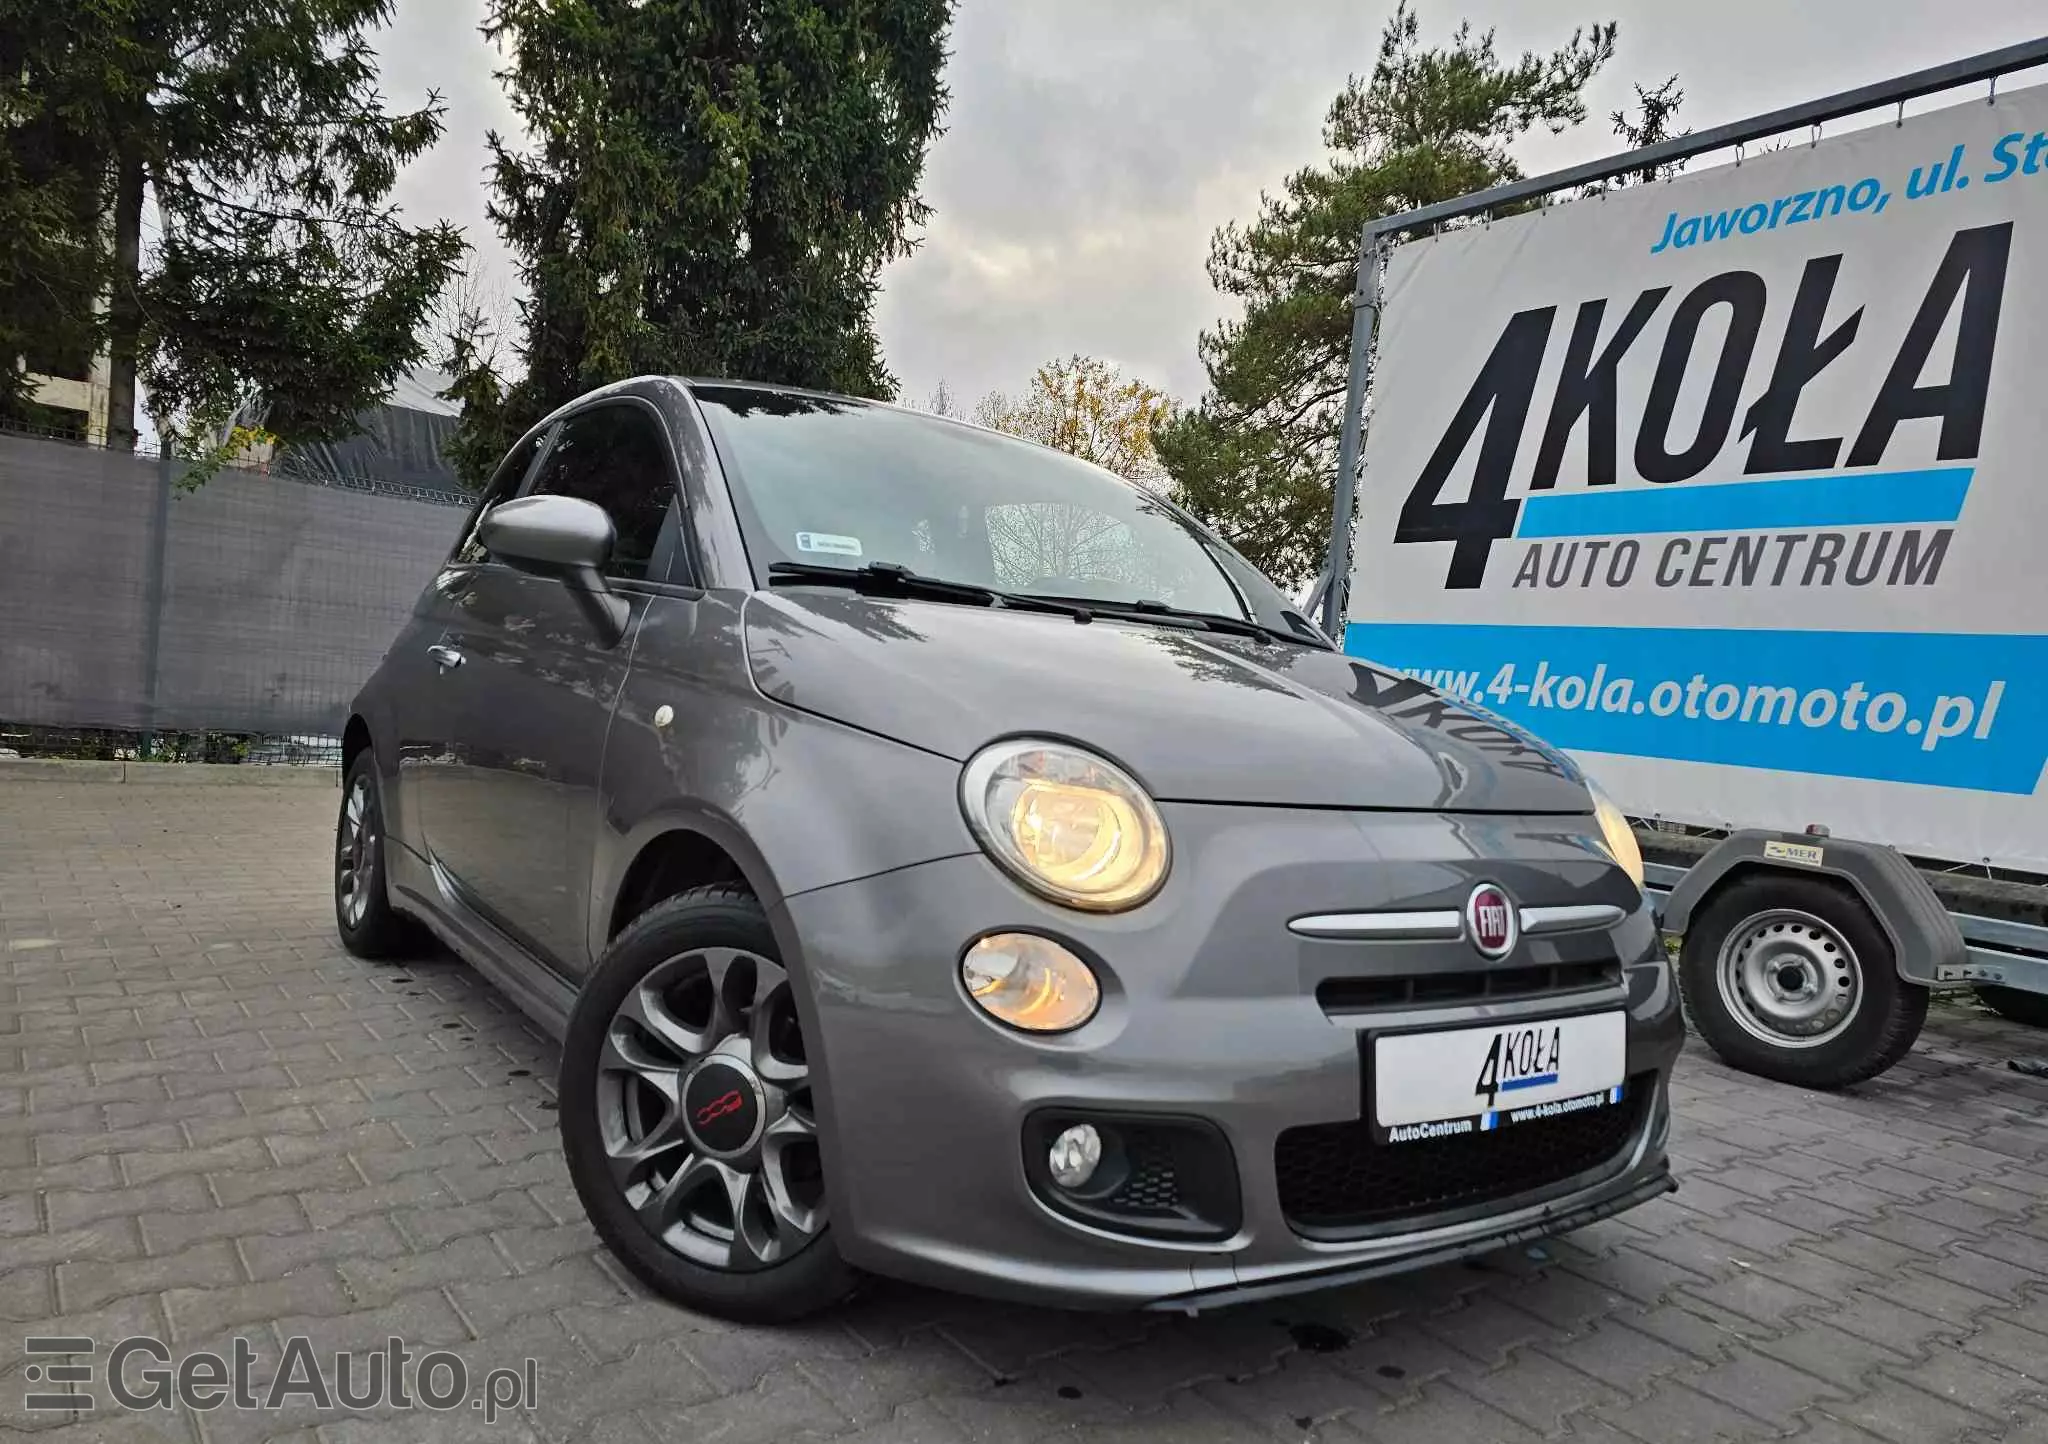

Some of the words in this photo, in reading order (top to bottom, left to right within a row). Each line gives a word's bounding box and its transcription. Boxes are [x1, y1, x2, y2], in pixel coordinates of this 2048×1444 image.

[1651, 177, 1894, 254] Jaworzno,
[1906, 143, 1970, 201] ul.
[1984, 130, 2048, 183] St
[1512, 538, 1640, 588] AUTO
[1655, 528, 1955, 588] CENTRUM
[1399, 660, 2007, 751] w.4-kola.otomoto.pl
[1388, 1119, 1473, 1143] AutoCentrum
